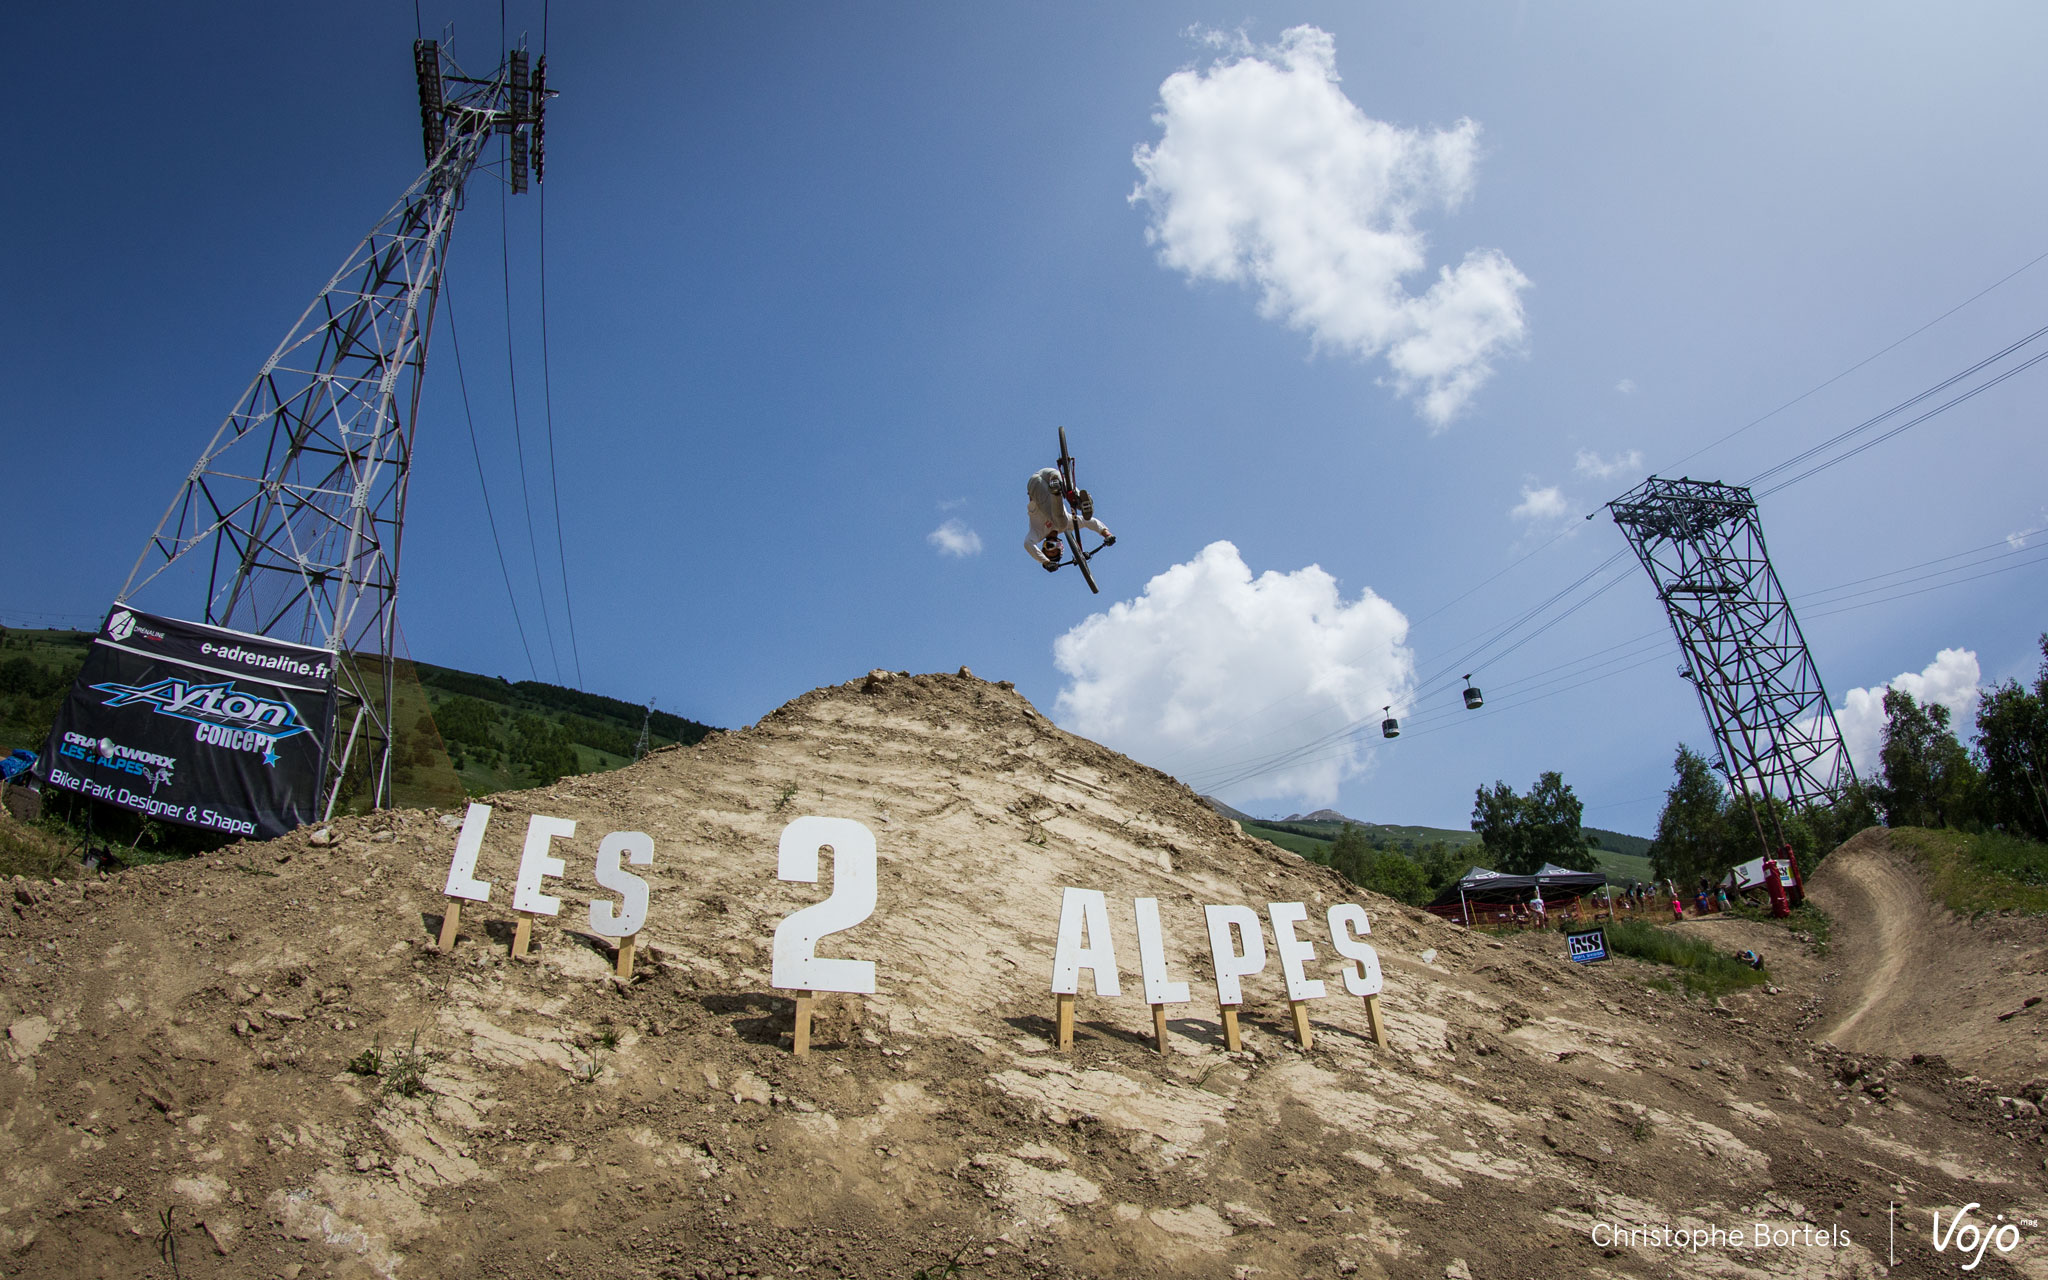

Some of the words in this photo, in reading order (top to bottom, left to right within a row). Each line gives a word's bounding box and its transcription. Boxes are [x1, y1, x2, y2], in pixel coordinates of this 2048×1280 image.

[201, 641, 331, 679] e-adrenaline.fr
[102, 679, 296, 730] Ayton
[60, 742, 86, 760] LES
[97, 756, 144, 776] ALPES
[64, 731, 176, 769] CRAKWORX
[50, 768, 80, 790] Bike
[81, 778, 115, 800] Park
[116, 788, 184, 818] Designer
[186, 805, 197, 822] &
[200, 809, 257, 835] Shaper
[444, 803, 655, 937] LES
[772, 816, 878, 994] 2
[1051, 887, 1383, 1005] ALPES
